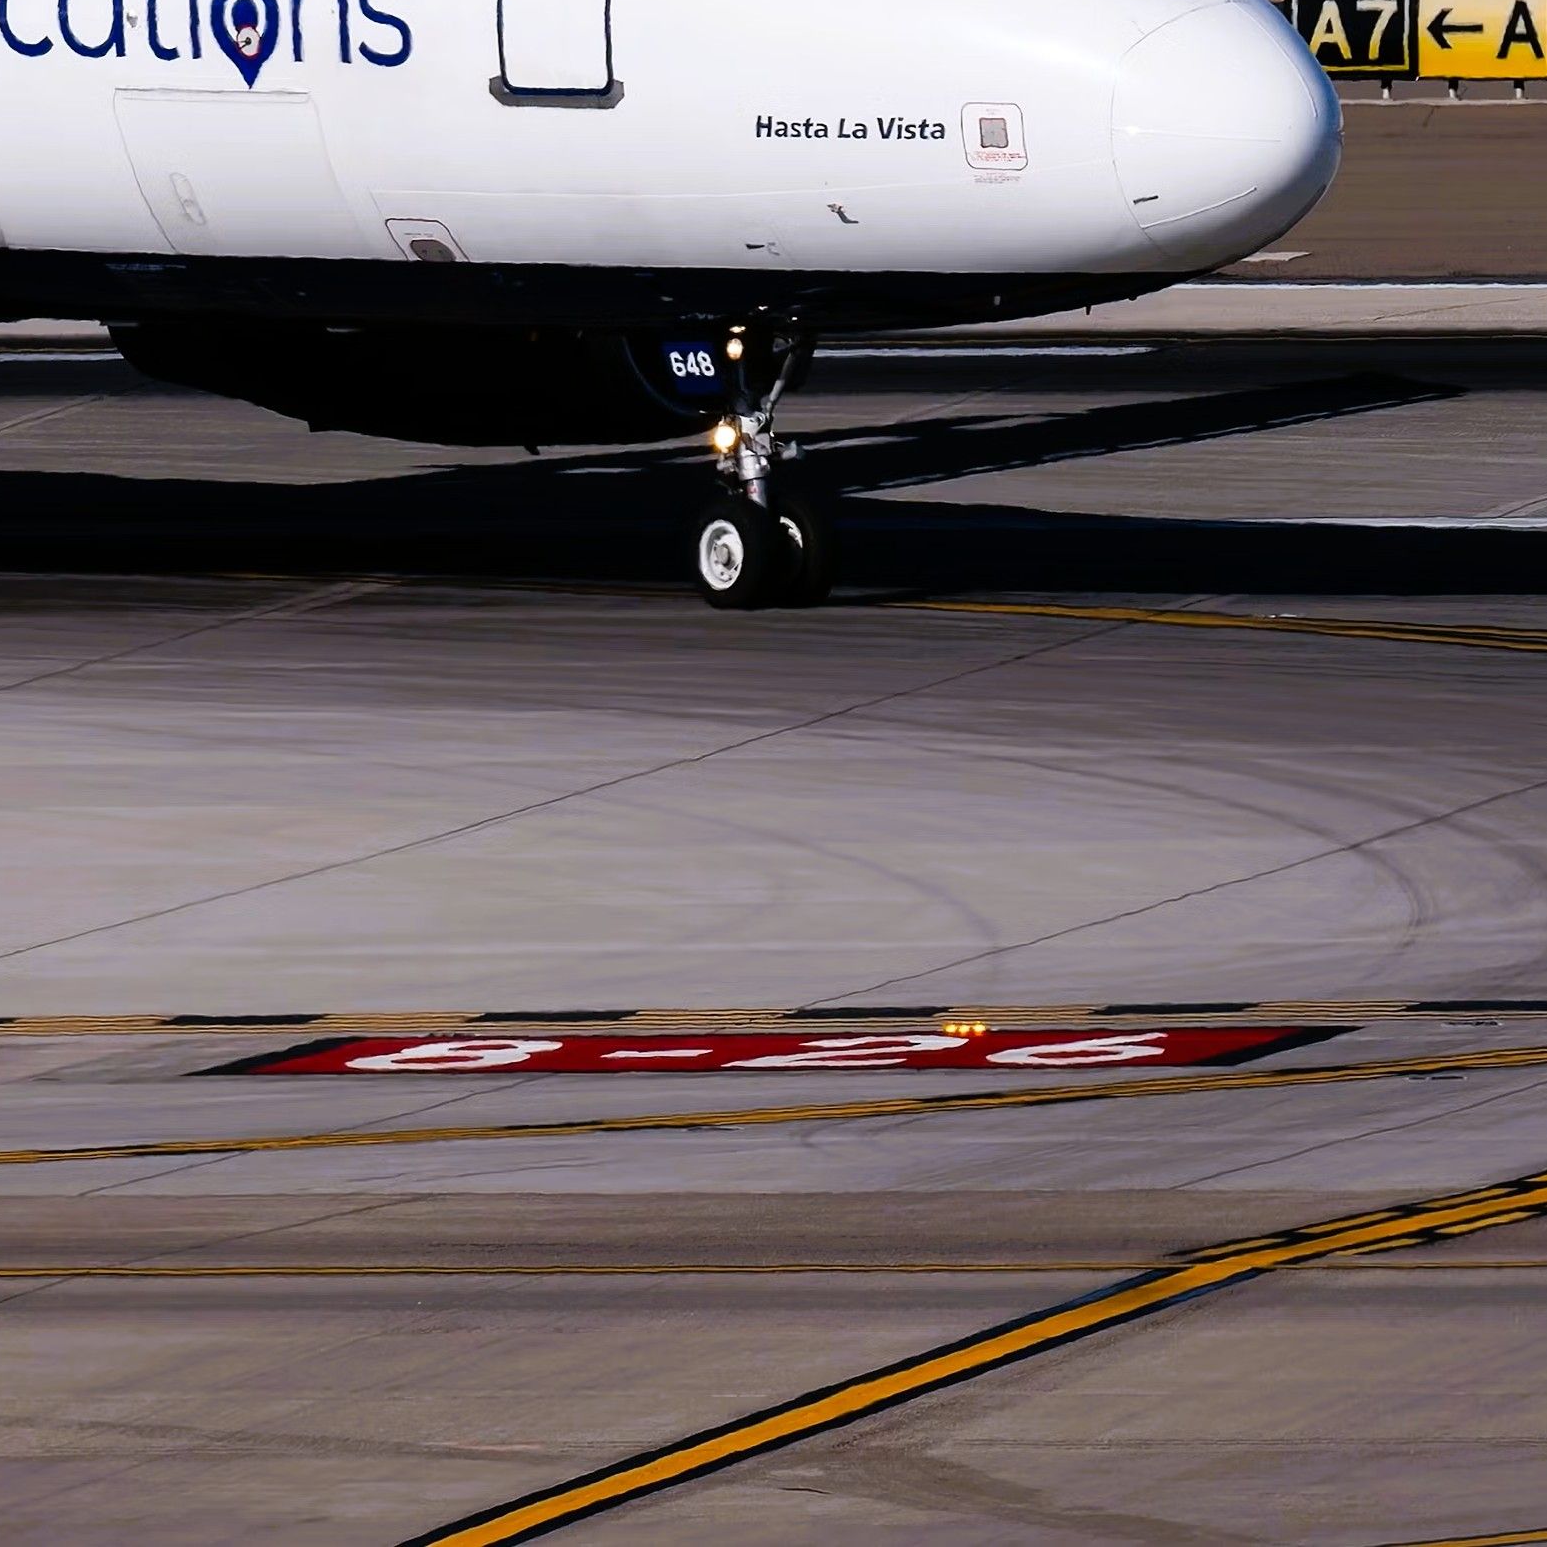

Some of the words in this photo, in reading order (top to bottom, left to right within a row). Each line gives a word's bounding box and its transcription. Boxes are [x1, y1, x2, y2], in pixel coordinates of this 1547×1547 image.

[1496, 0, 1545, 60] A
[755, 115, 829, 139] Hasta
[837, 117, 868, 140] La
[876, 117, 946, 140] Vista
[669, 350, 715, 377] 648
[343, 1031, 1168, 1071] 8-26
